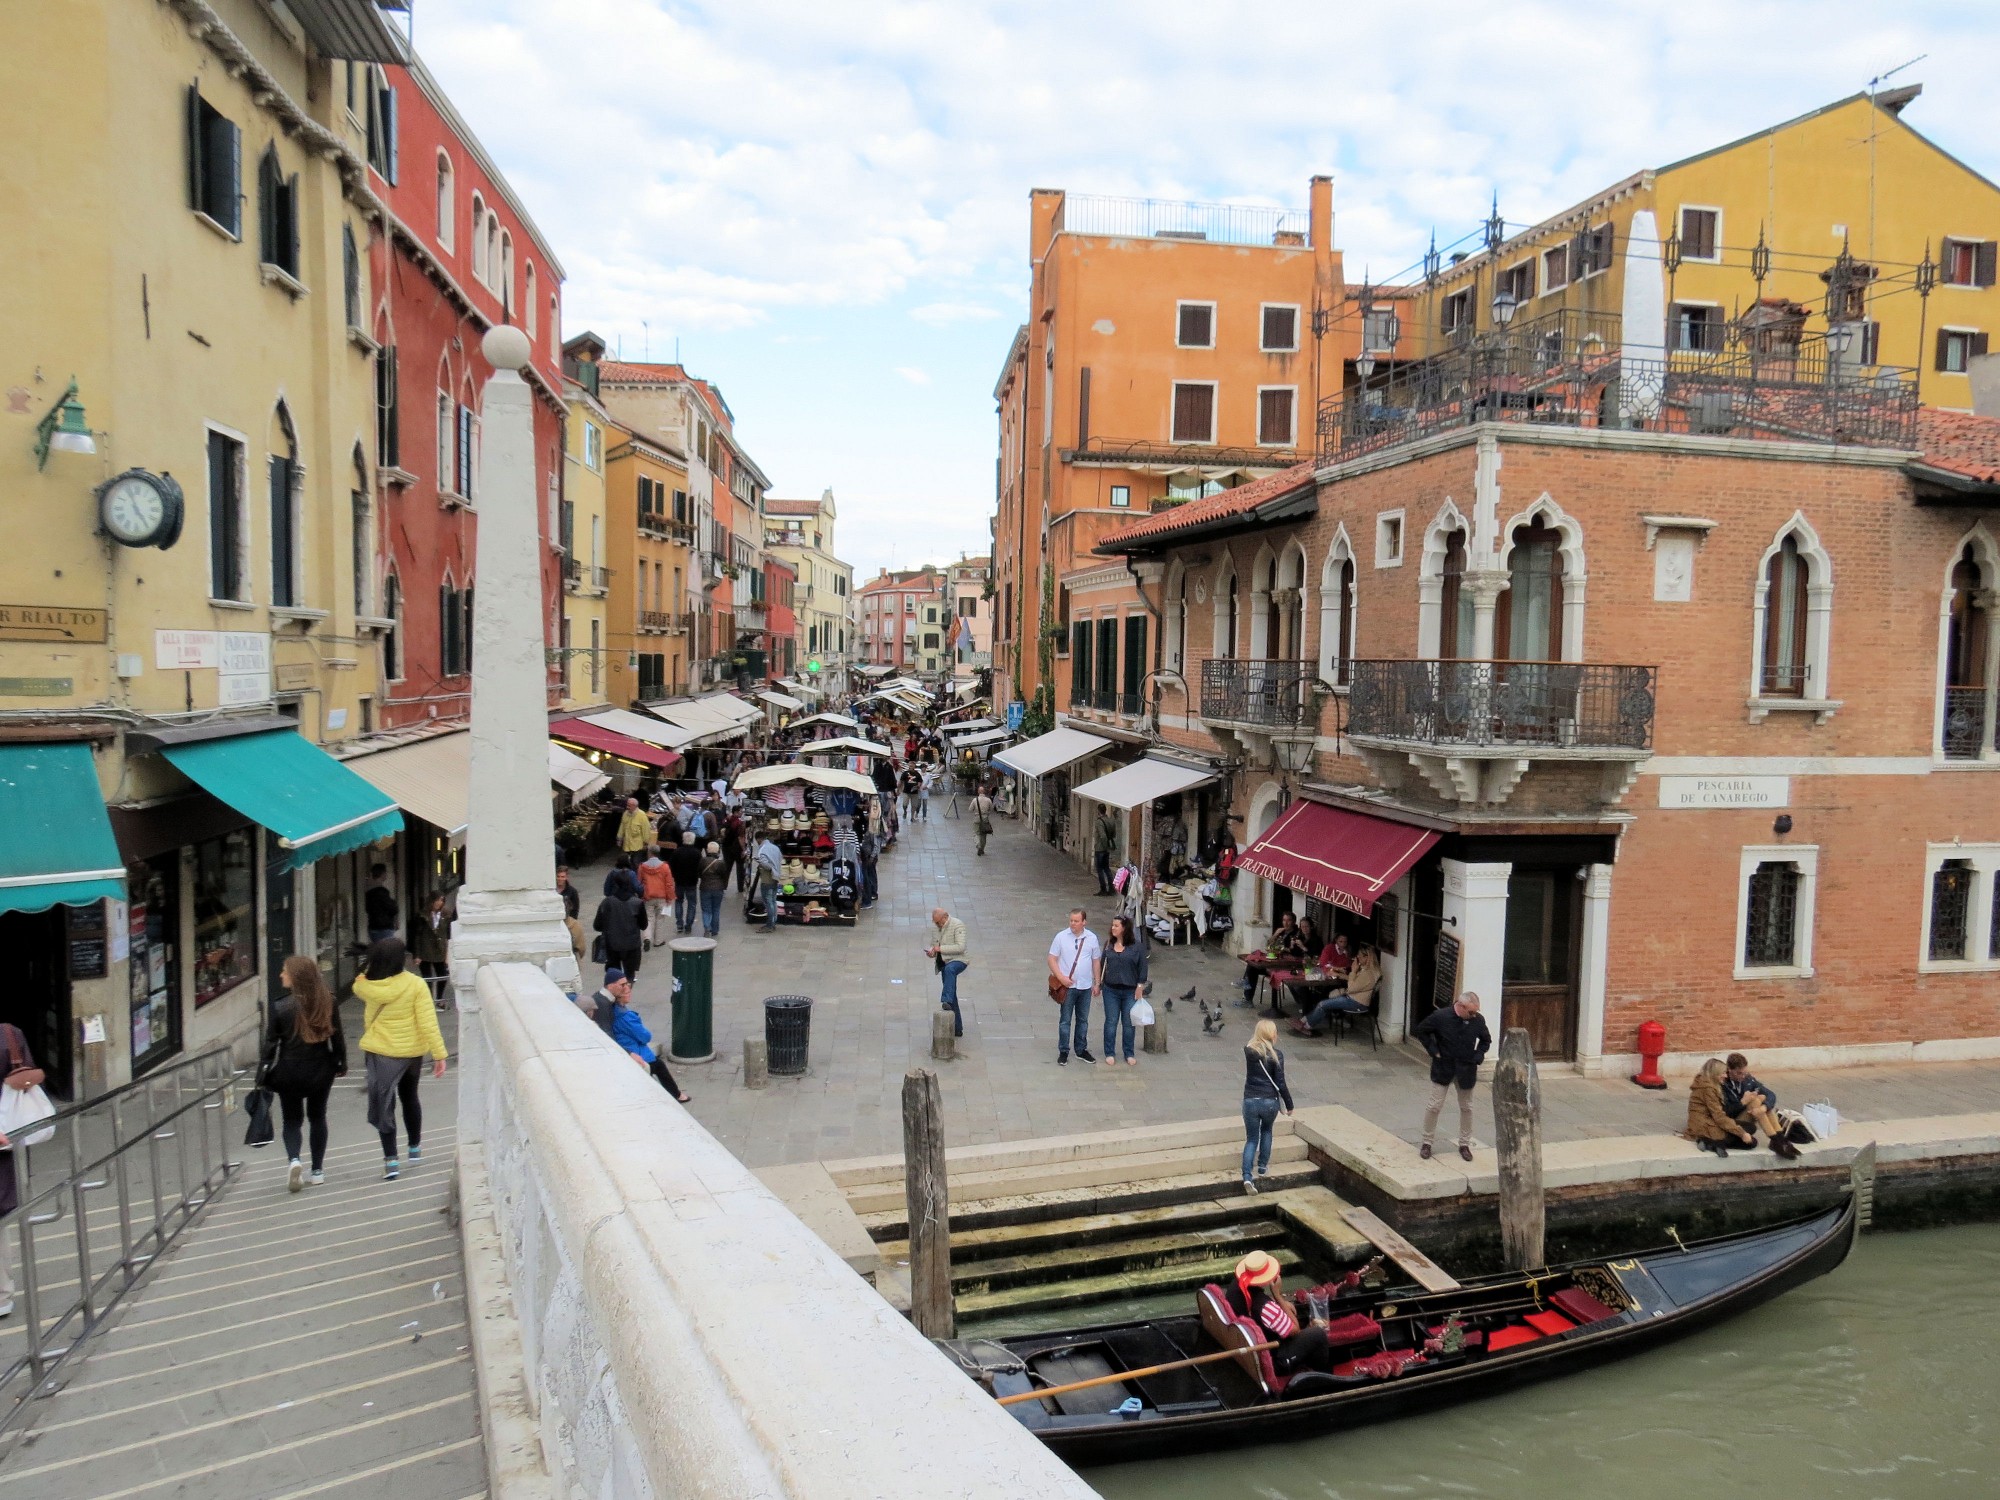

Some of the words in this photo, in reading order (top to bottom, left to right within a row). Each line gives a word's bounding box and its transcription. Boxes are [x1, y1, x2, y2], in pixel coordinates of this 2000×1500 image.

[21, 611, 96, 625] RIALTO
[1697, 781, 1752, 790] PESCARIA
[1680, 794, 1695, 803] DE
[1703, 793, 1768, 802] CANAREGIO
[1240, 857, 1285, 884] TRATTORIA
[1288, 874, 1310, 893] ALLA
[1314, 882, 1363, 913] PALAZZINA
